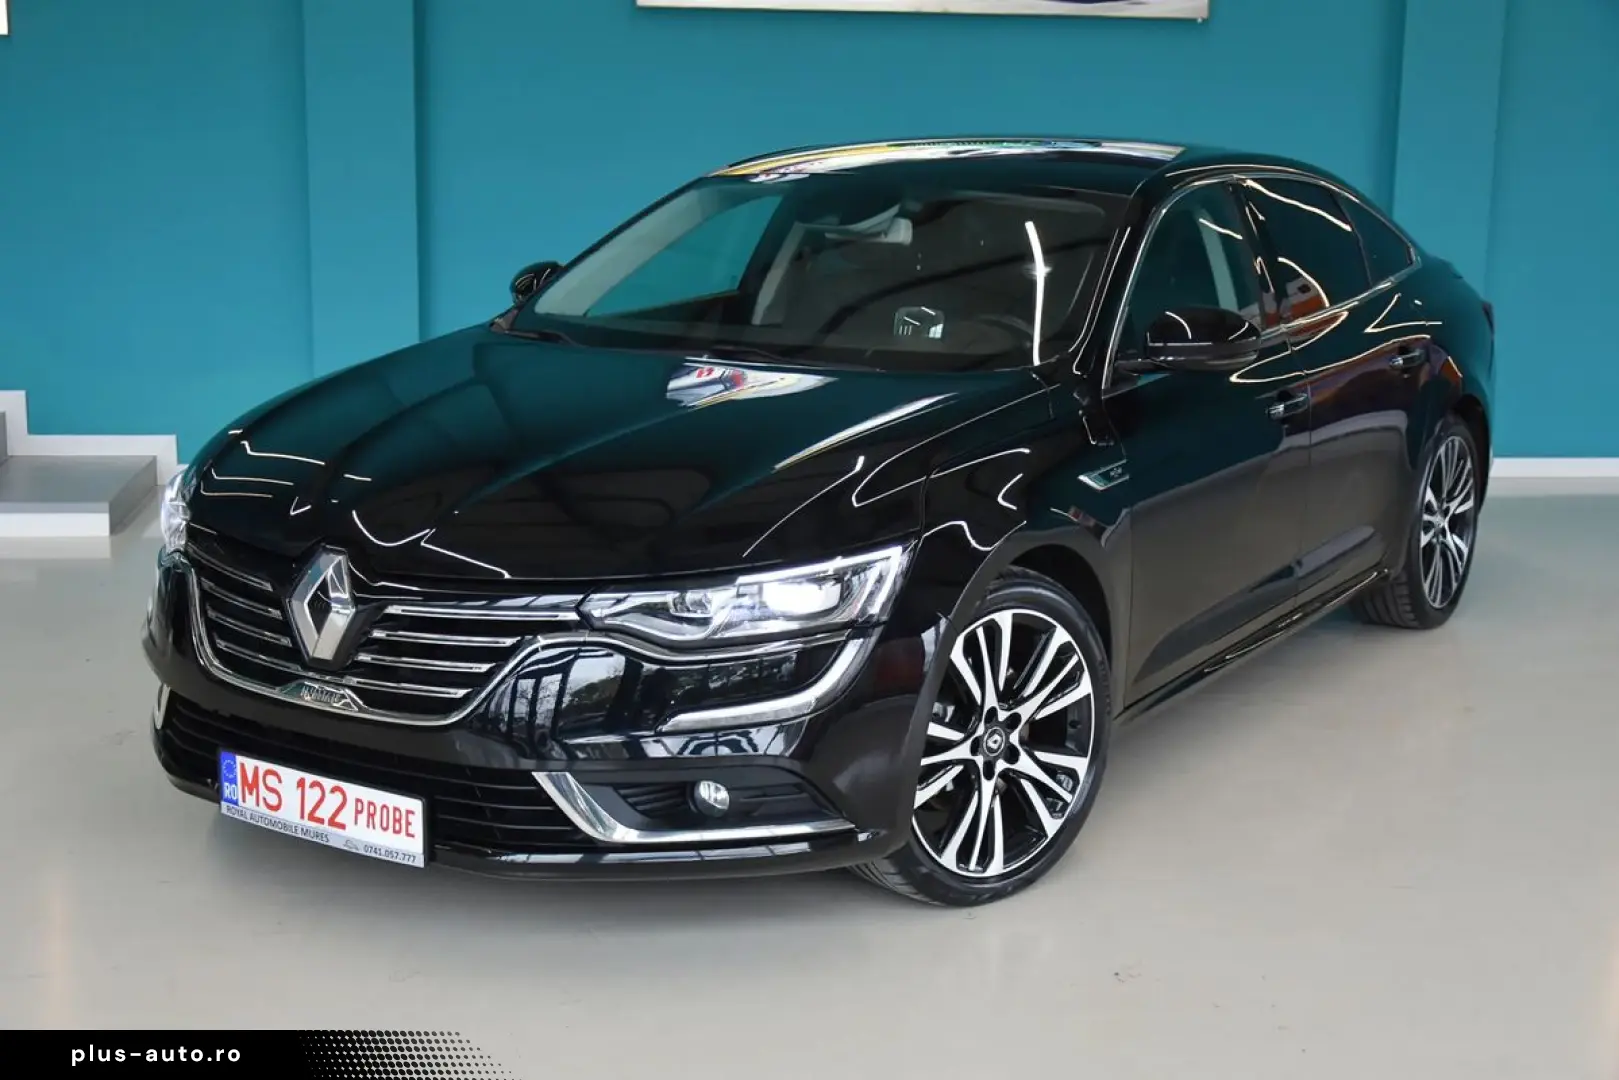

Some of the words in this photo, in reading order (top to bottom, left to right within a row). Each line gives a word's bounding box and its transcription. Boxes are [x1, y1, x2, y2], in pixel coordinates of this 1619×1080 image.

[224, 782, 238, 799] RO
[239, 762, 283, 812] MS
[296, 777, 347, 830] 122
[354, 797, 416, 839] PROBE
[226, 805, 248, 820] ROYAL
[249, 812, 299, 835] AUTOMOBILE
[363, 843, 417, 864] 0741.057.777
